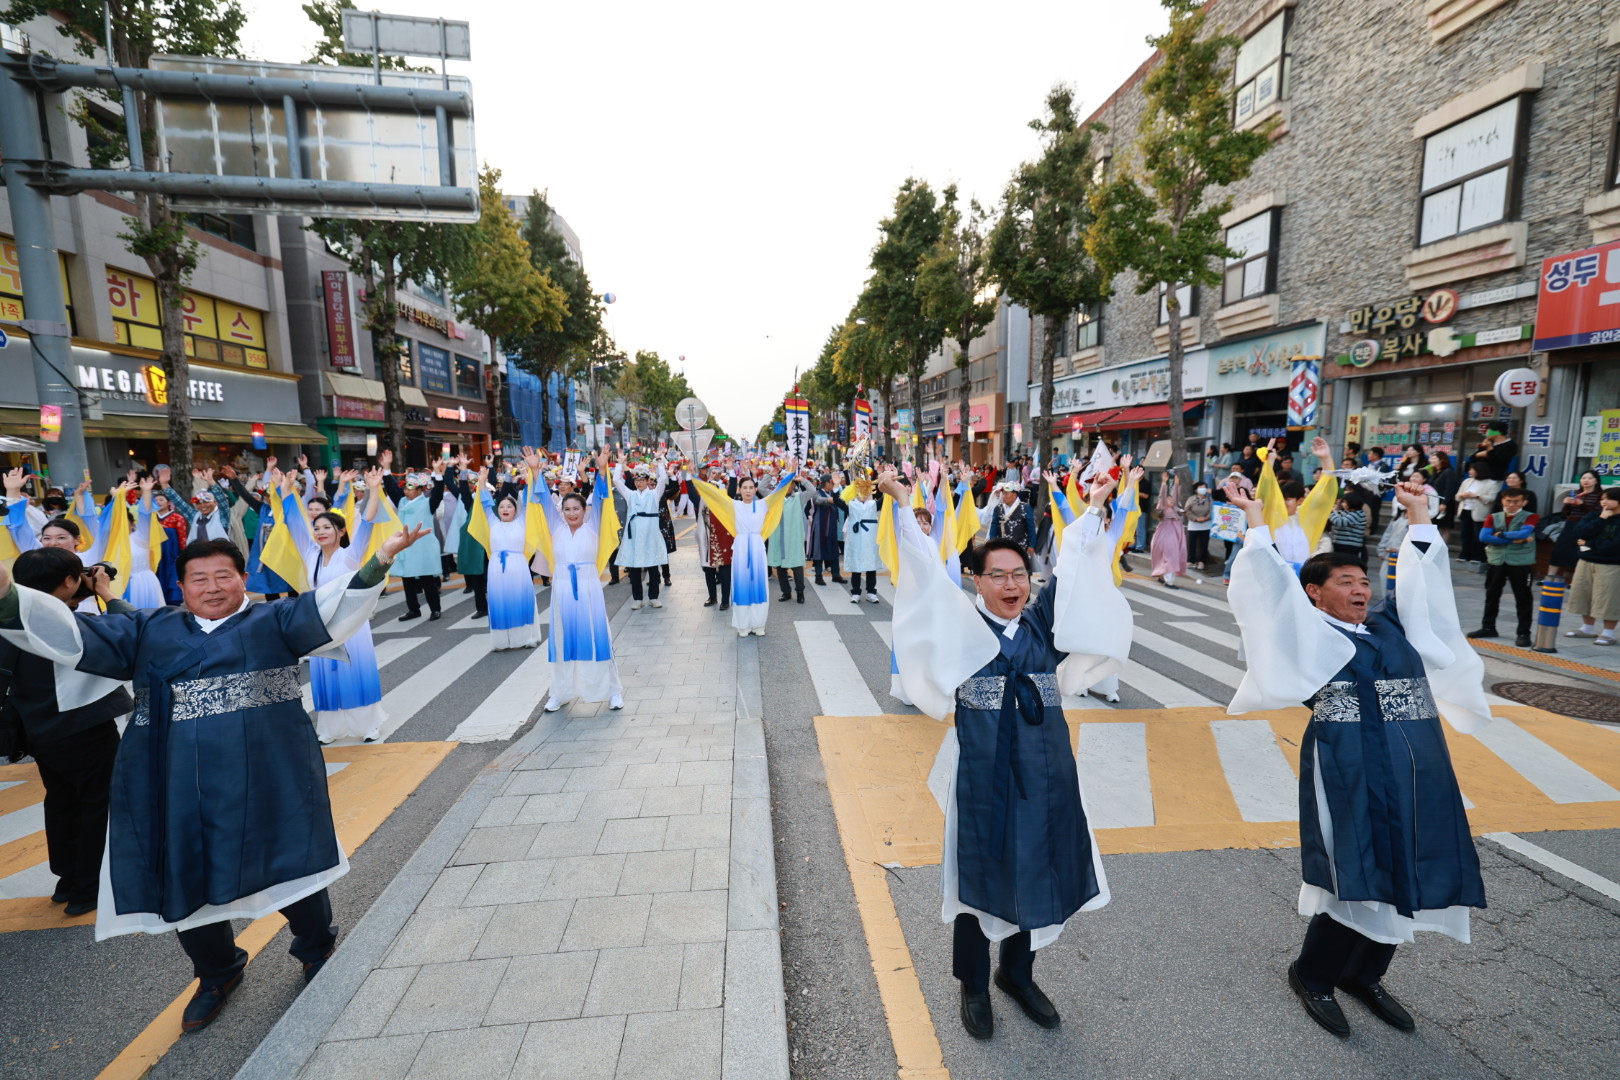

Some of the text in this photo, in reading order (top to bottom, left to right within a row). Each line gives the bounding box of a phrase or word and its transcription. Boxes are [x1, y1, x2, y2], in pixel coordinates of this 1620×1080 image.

[1546, 254, 1599, 293] 성두
[107, 273, 254, 341] 하우스
[330, 282, 349, 355] 아름다운 피부과
[1350, 296, 1422, 335] 만우당
[1381, 332, 1423, 362] 복사
[76, 365, 225, 402] MEGA FFEE
[1510, 381, 1538, 396] 도장
[1522, 424, 1551, 477] 복사
